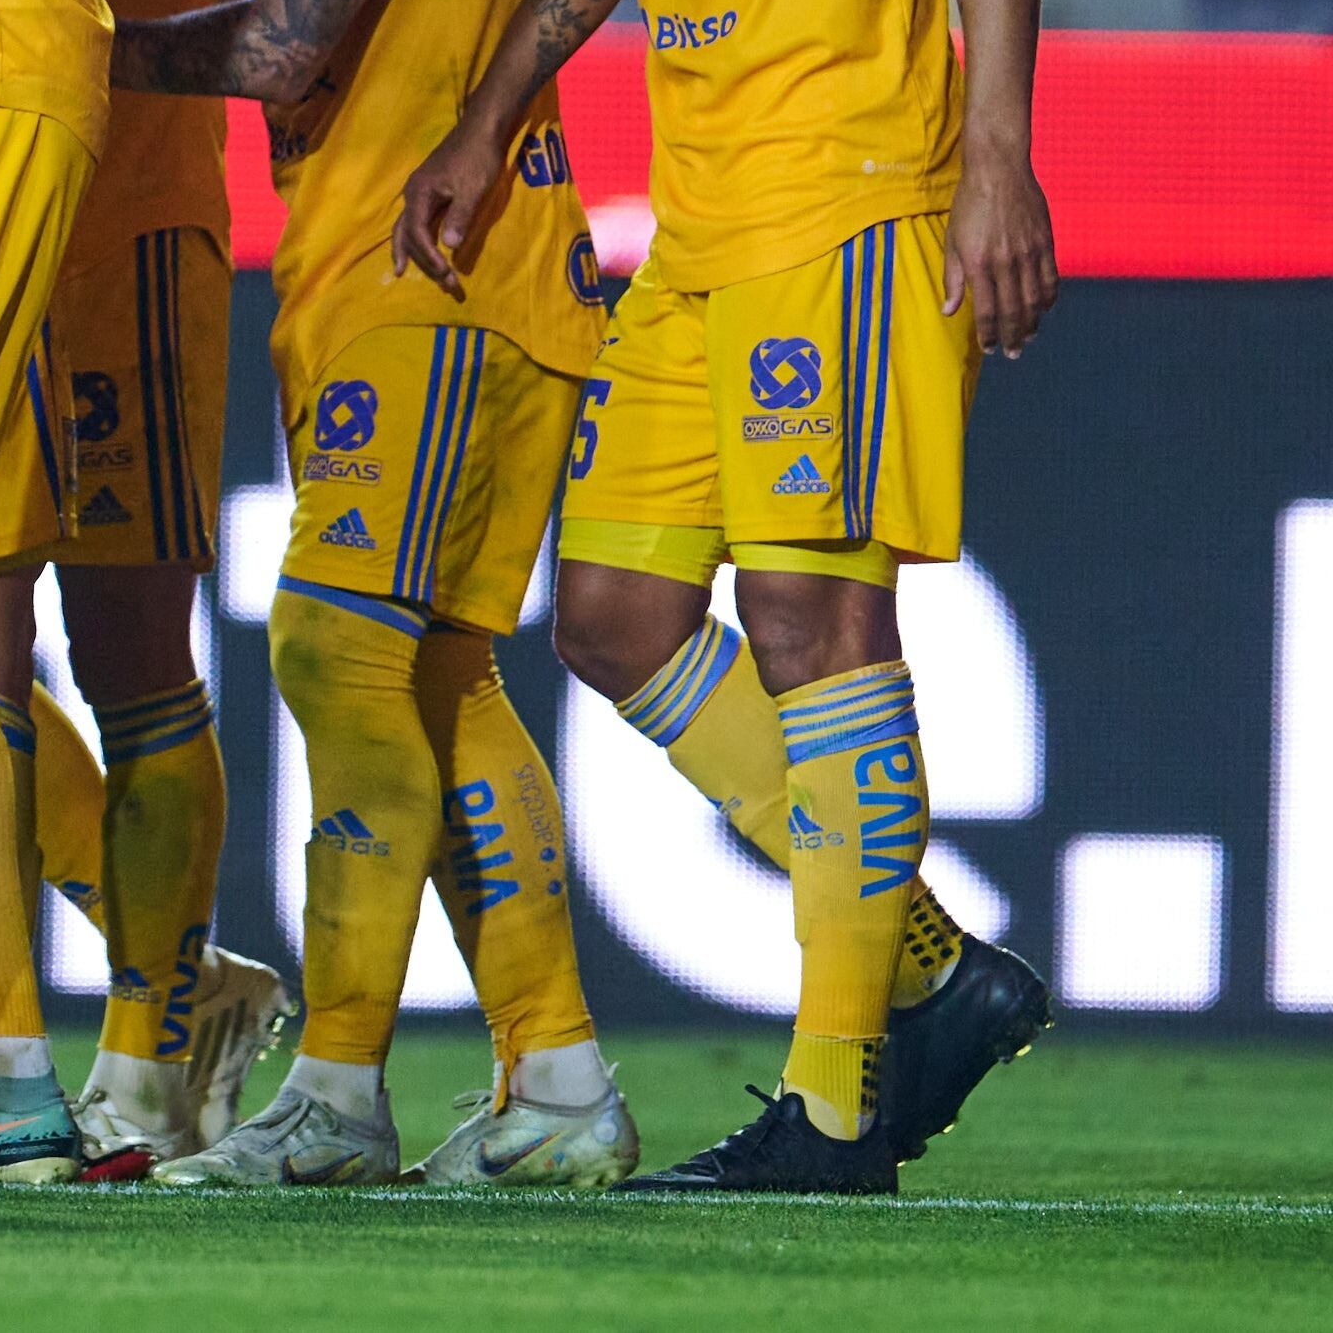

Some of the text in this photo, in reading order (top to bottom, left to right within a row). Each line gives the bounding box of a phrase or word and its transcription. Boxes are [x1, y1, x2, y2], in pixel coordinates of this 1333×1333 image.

[655, 10, 738, 51] Bitso
[780, 418, 832, 434] GAS
[771, 478, 831, 494] adidas
[318, 530, 377, 551] adidas
